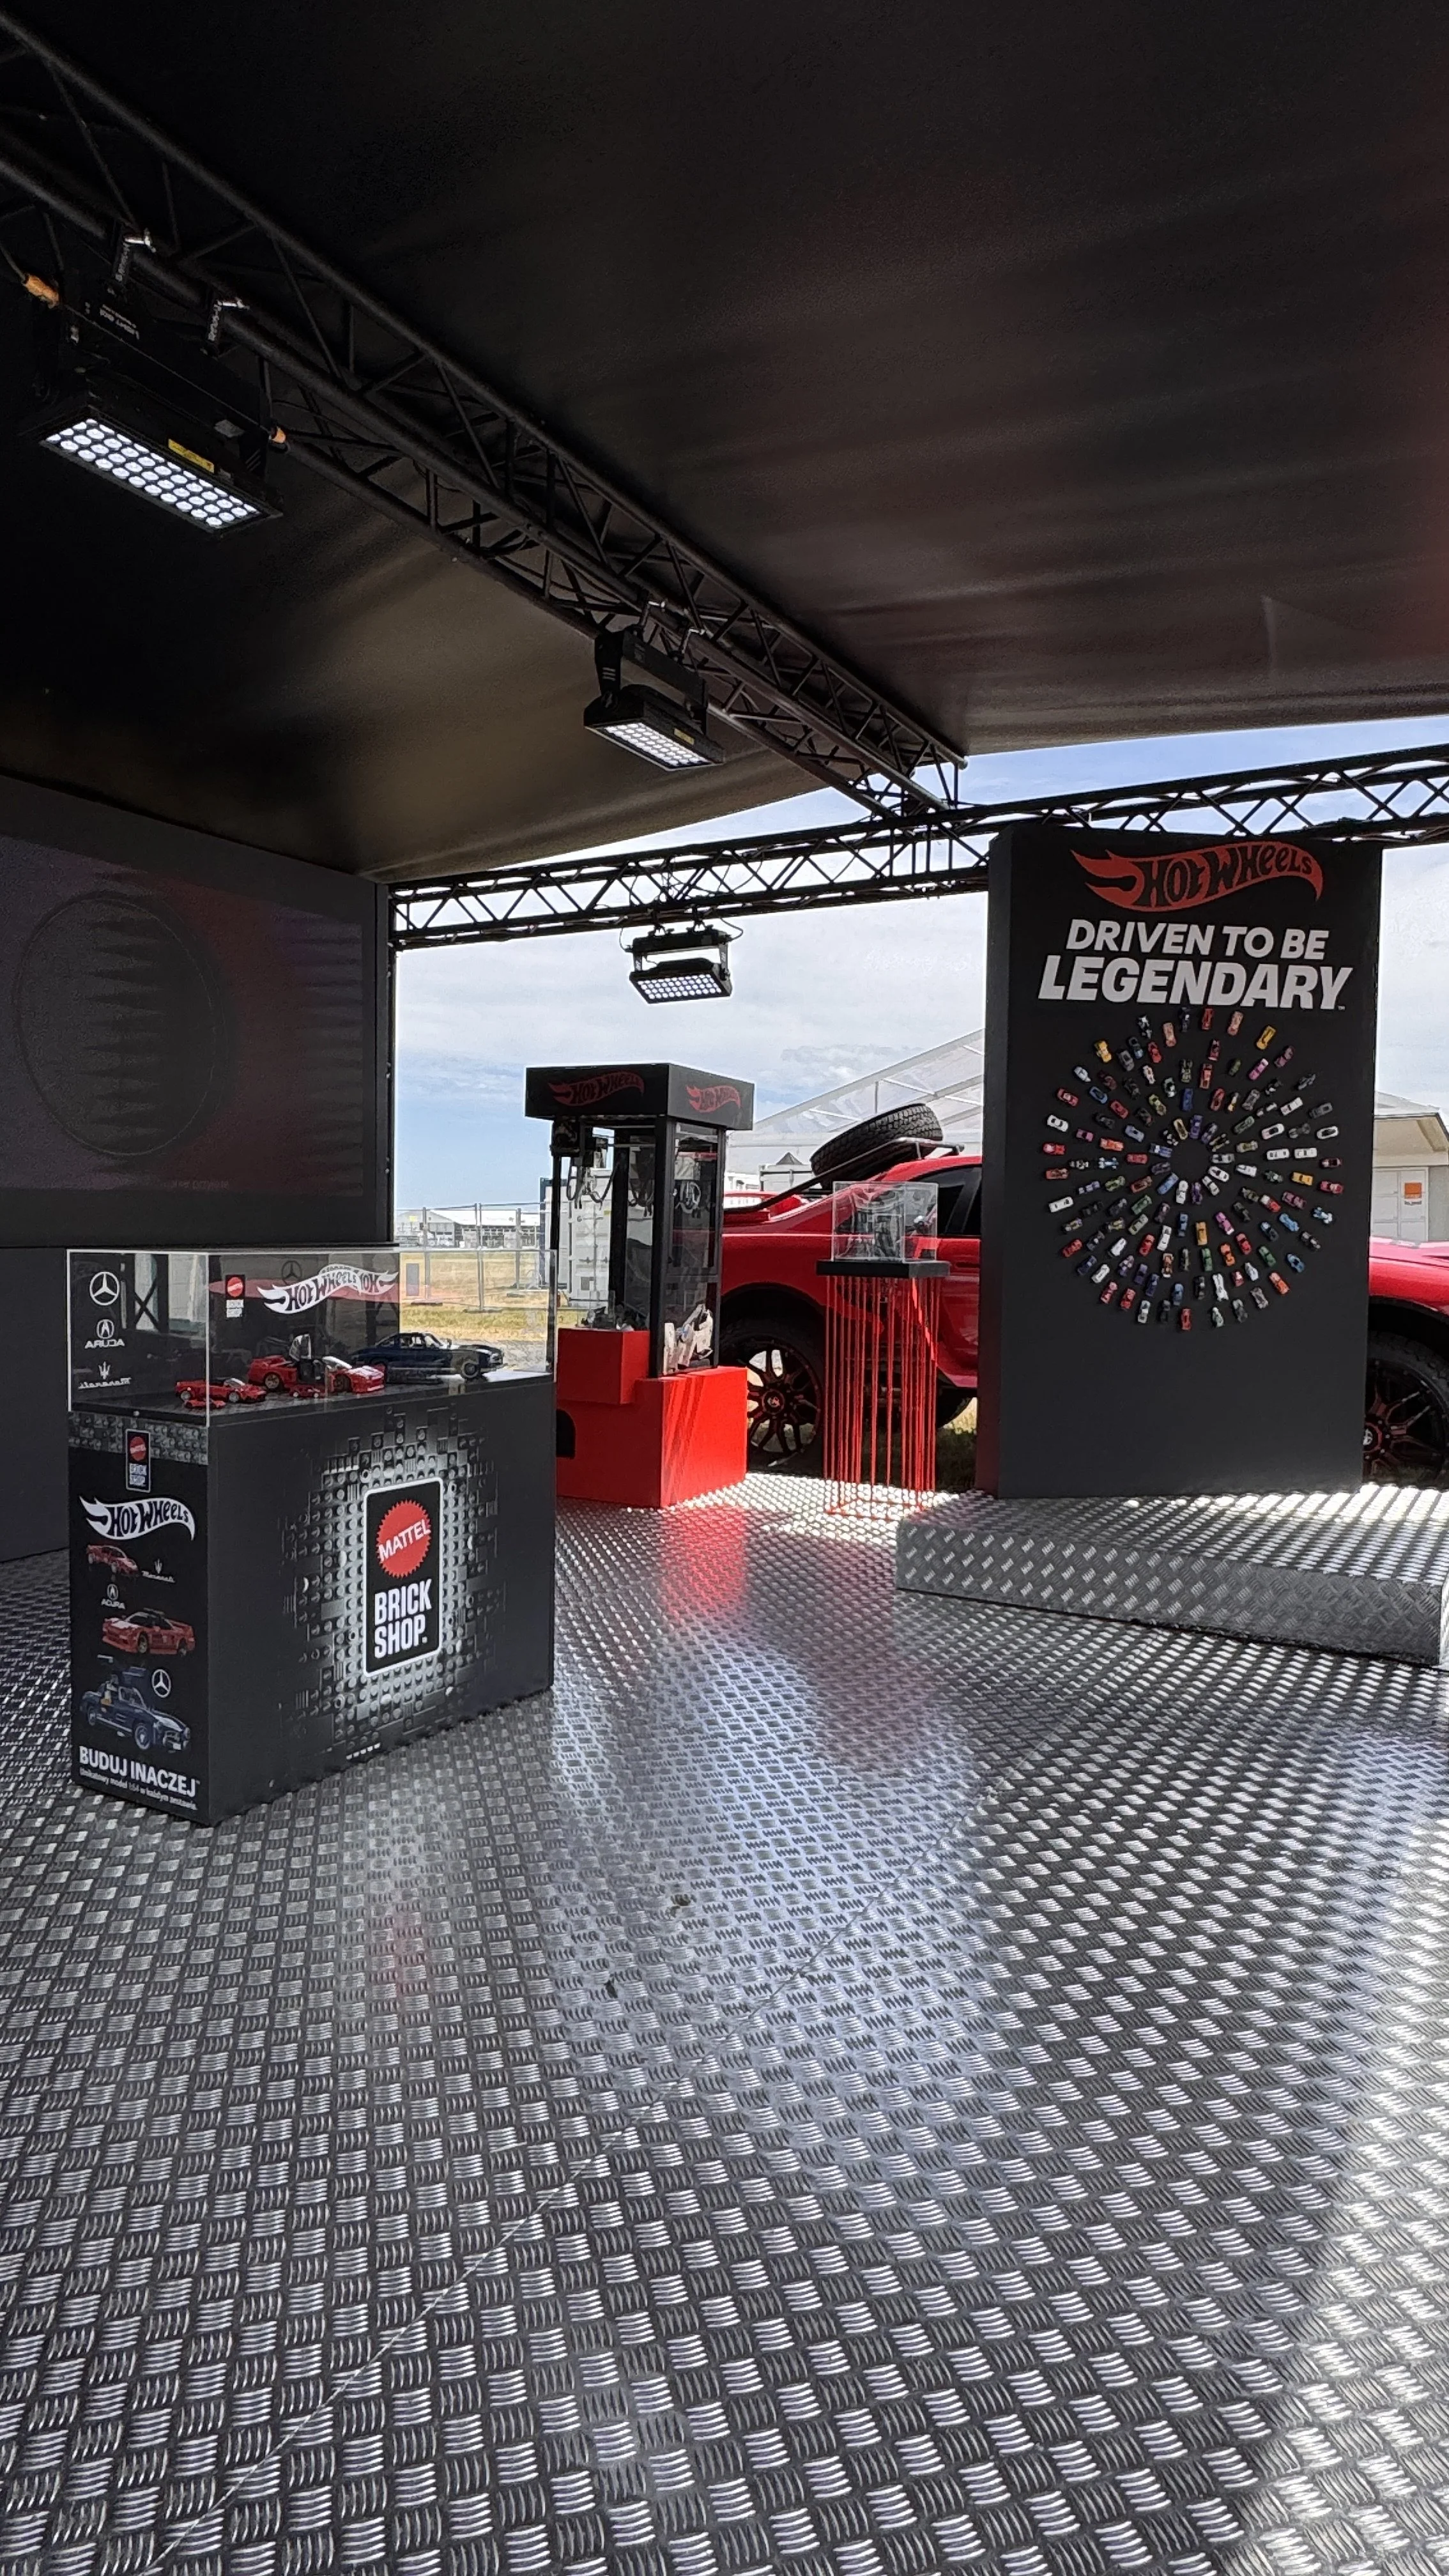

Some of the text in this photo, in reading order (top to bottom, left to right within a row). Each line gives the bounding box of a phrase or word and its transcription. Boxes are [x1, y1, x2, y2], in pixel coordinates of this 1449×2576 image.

[1131, 844, 1312, 907] HOT WHEELS
[1066, 918, 1330, 960] DRIVEN TO BE
[1038, 954, 1354, 1009] LEGENDARY
[285, 1271, 356, 1311] HOT WHEELS
[106, 1501, 190, 1537] HOT WHEELS
[378, 1517, 432, 1563] MATTEL
[101, 1598, 125, 1610] ACURA
[374, 1577, 433, 1627] BRICK
[374, 1613, 428, 1659] SHOP.
[79, 1745, 128, 1779] BUDUJ
[130, 1760, 197, 1798] INACZEJ
